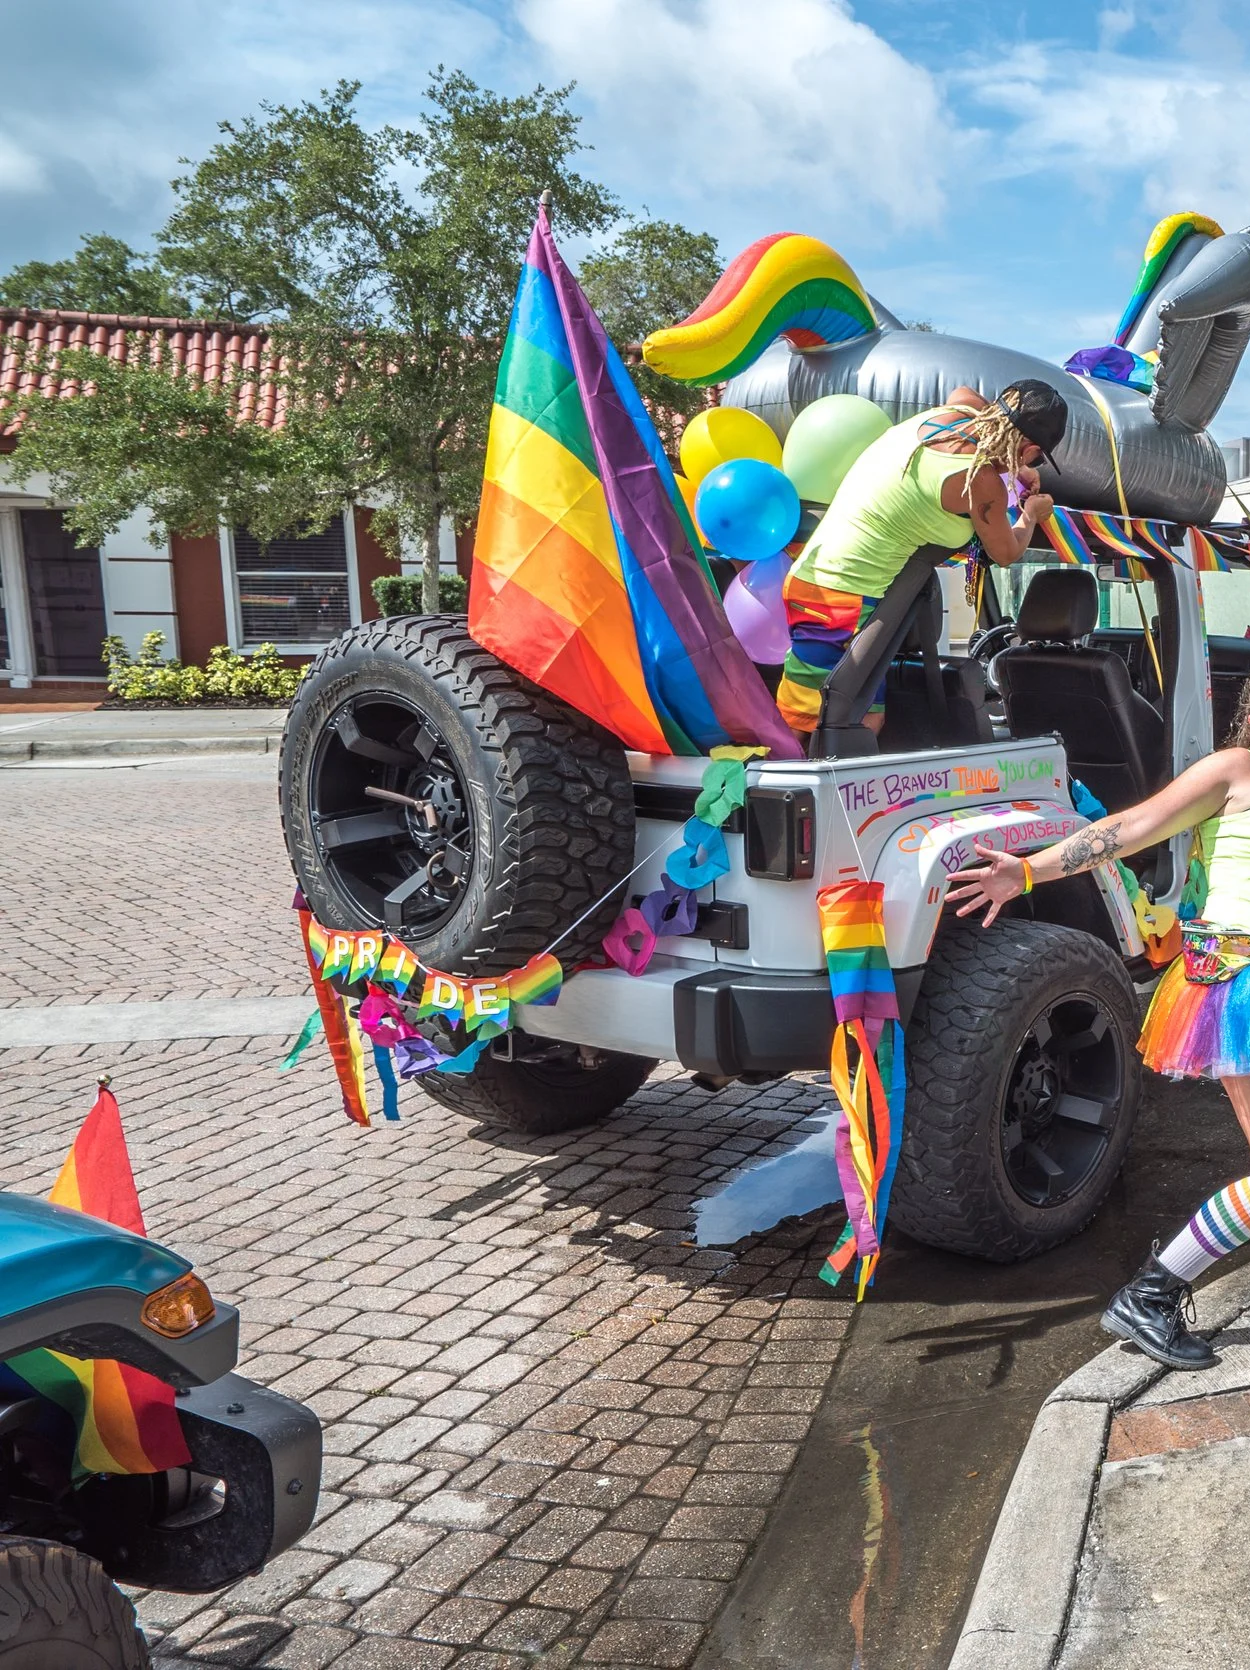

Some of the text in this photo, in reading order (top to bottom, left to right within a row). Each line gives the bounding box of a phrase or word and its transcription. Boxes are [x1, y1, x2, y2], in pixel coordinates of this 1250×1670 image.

[839, 758, 1053, 811] THE BRAVEST THING YOU CAN
[940, 840, 970, 874] BE
[995, 820, 1077, 853] YOURSELF!
[332, 936, 500, 1016] PRIDE
